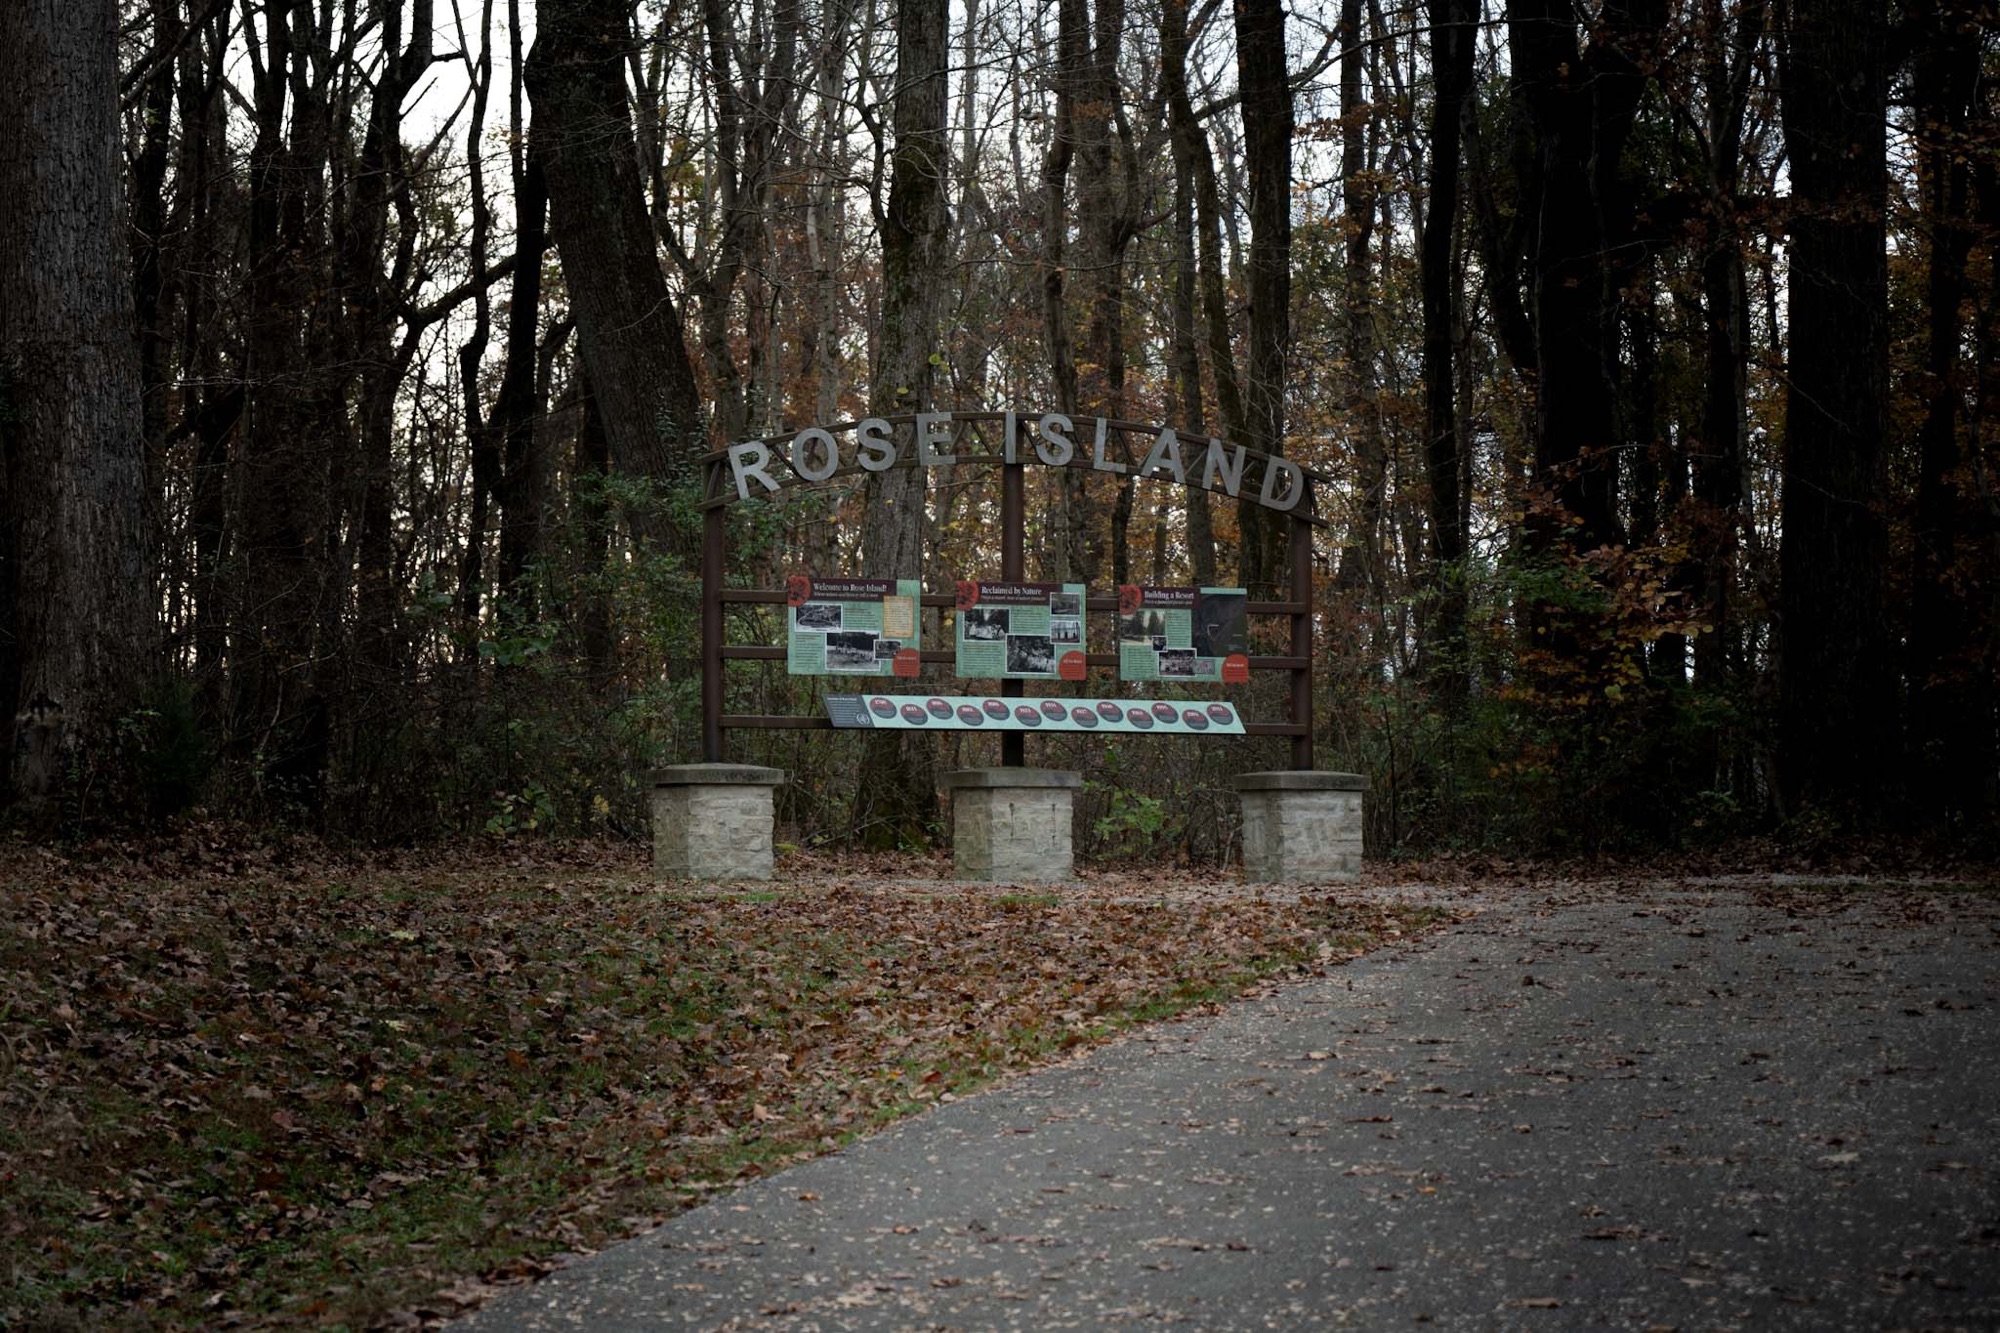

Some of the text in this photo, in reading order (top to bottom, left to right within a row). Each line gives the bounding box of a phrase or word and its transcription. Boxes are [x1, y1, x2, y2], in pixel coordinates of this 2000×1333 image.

[728, 411, 1303, 512] ROSE ISLAND
[813, 583, 842, 591] Welcome
[850, 584, 864, 592] Rose
[981, 586, 1042, 596] Reclaimed by Nature
[1144, 590, 1170, 600] Building
[1175, 591, 1195, 599] Resort
